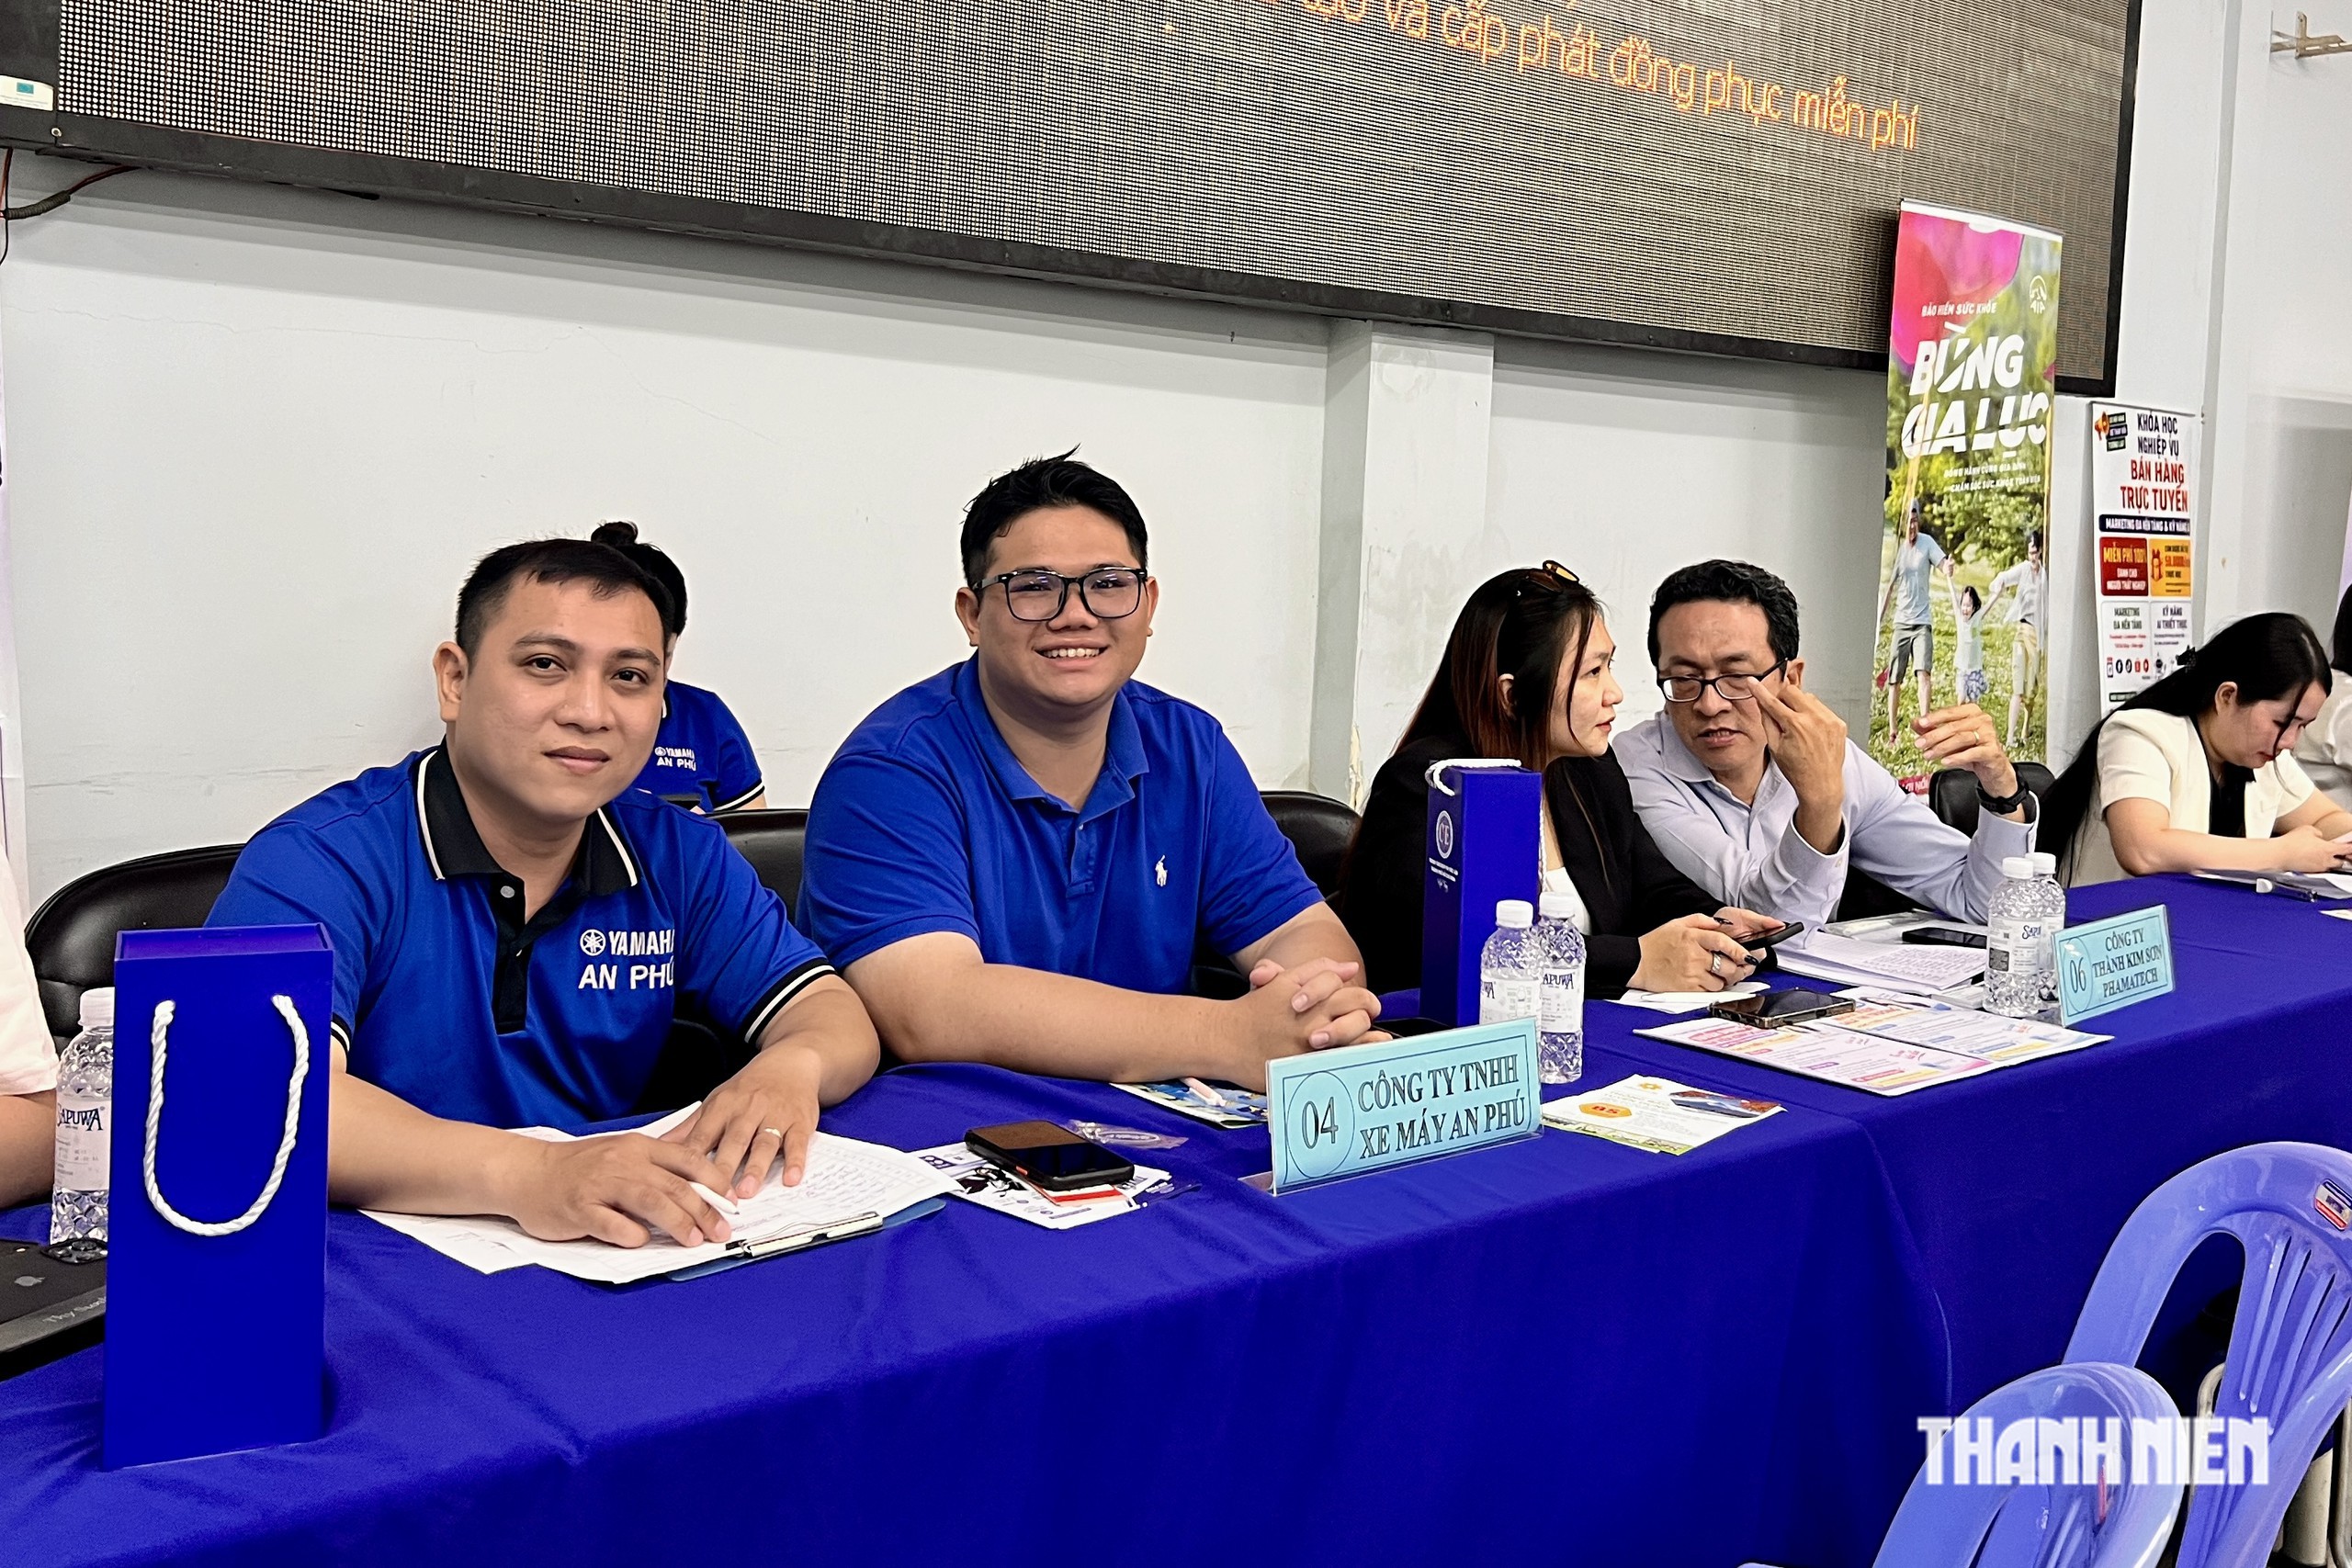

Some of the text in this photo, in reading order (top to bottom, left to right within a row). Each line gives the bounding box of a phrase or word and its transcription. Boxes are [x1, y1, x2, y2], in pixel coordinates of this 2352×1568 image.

[1519, 15, 1601, 79] phát
[1610, 34, 1696, 111] đồng
[1703, 60, 1784, 126] phục
[1792, 75, 1865, 139] miễn
[1871, 100, 1920, 152] phí
[1901, 400, 1967, 459] GIA
[2162, 417, 2178, 436] HỌC
[2138, 435, 2167, 458] NGHIỆP
[2131, 456, 2185, 484] BÁN HÀNG
[2120, 482, 2188, 513] TRỰC TUYẾN
[657, 756, 673, 767] AN
[2105, 928, 2144, 952] CÔNG TY
[2126, 951, 2144, 967] KIM
[2144, 943, 2162, 962] SƠN
[578, 964, 617, 990] AN
[2069, 957, 2086, 994] 06
[2103, 967, 2159, 998] PHAMATECH
[1358, 1054, 1520, 1112] CÔNG TY TNHH
[1301, 1096, 1339, 1149] 04
[1359, 1089, 1526, 1159] XE MÁY AN PHÚ
